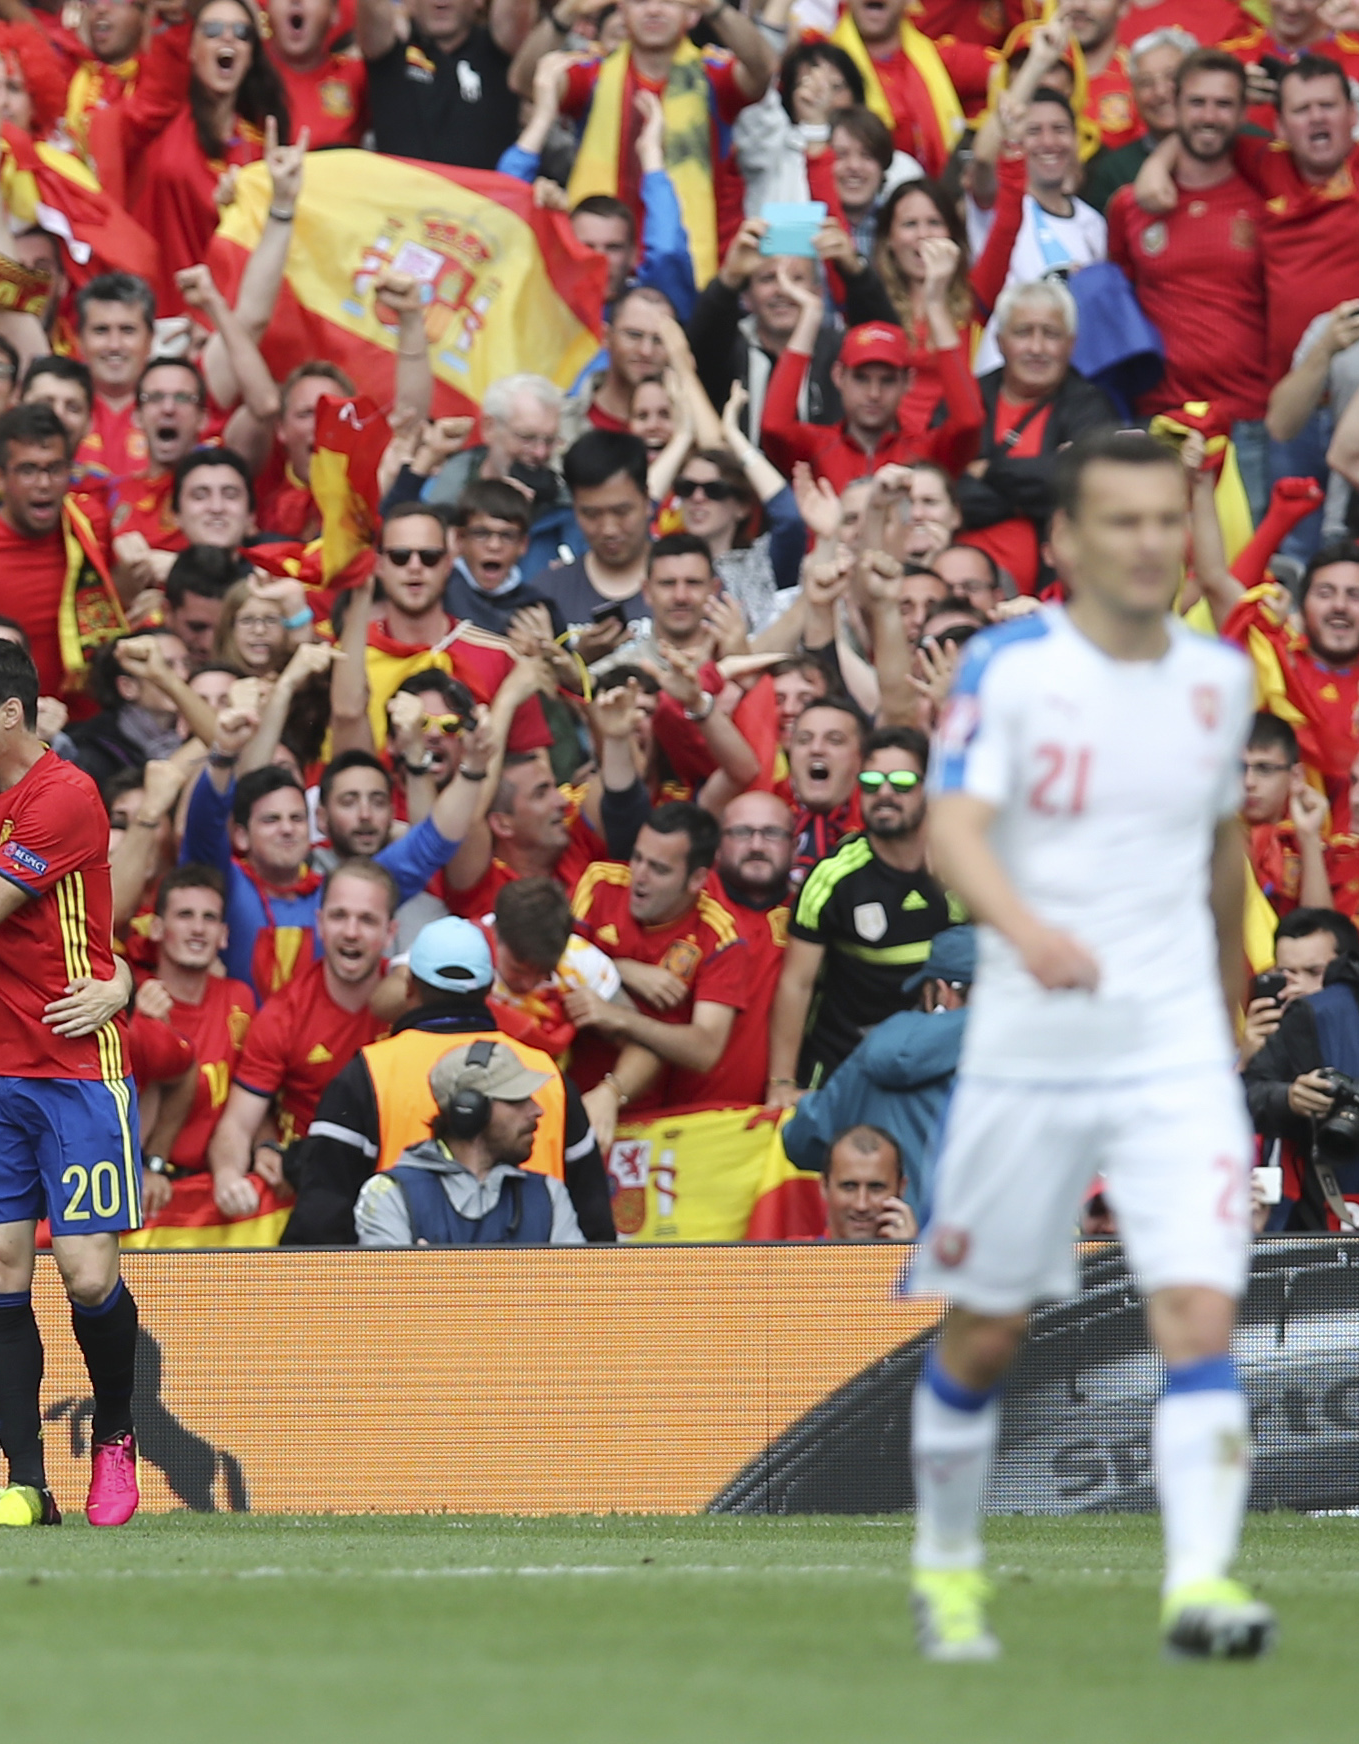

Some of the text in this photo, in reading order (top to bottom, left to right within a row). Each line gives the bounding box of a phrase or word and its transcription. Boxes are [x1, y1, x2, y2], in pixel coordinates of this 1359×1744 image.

[1028, 741, 1090, 817] 21
[15, 848, 47, 872] RESPECT
[62, 1160, 120, 1221] 20
